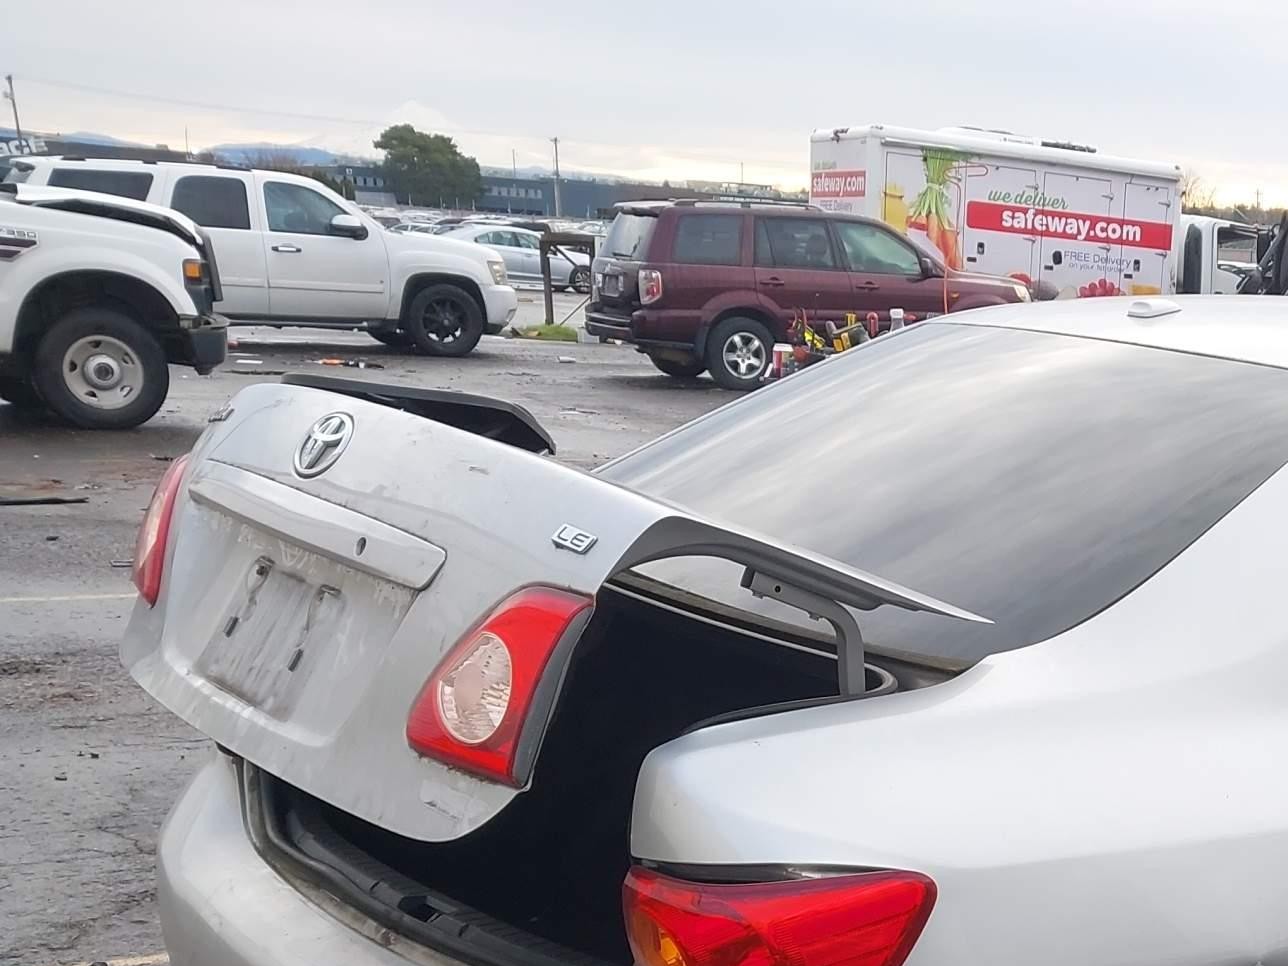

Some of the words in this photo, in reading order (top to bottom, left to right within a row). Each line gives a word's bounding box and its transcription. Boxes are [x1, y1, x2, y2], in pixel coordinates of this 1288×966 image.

[813, 173, 864, 196] safeway.com
[988, 189, 1011, 203] we
[1014, 190, 1069, 210] deliver
[1001, 208, 1141, 242] safeway.com
[1064, 250, 1090, 262] FREE
[1093, 254, 1131, 269] Delivery
[557, 526, 590, 548] LE
